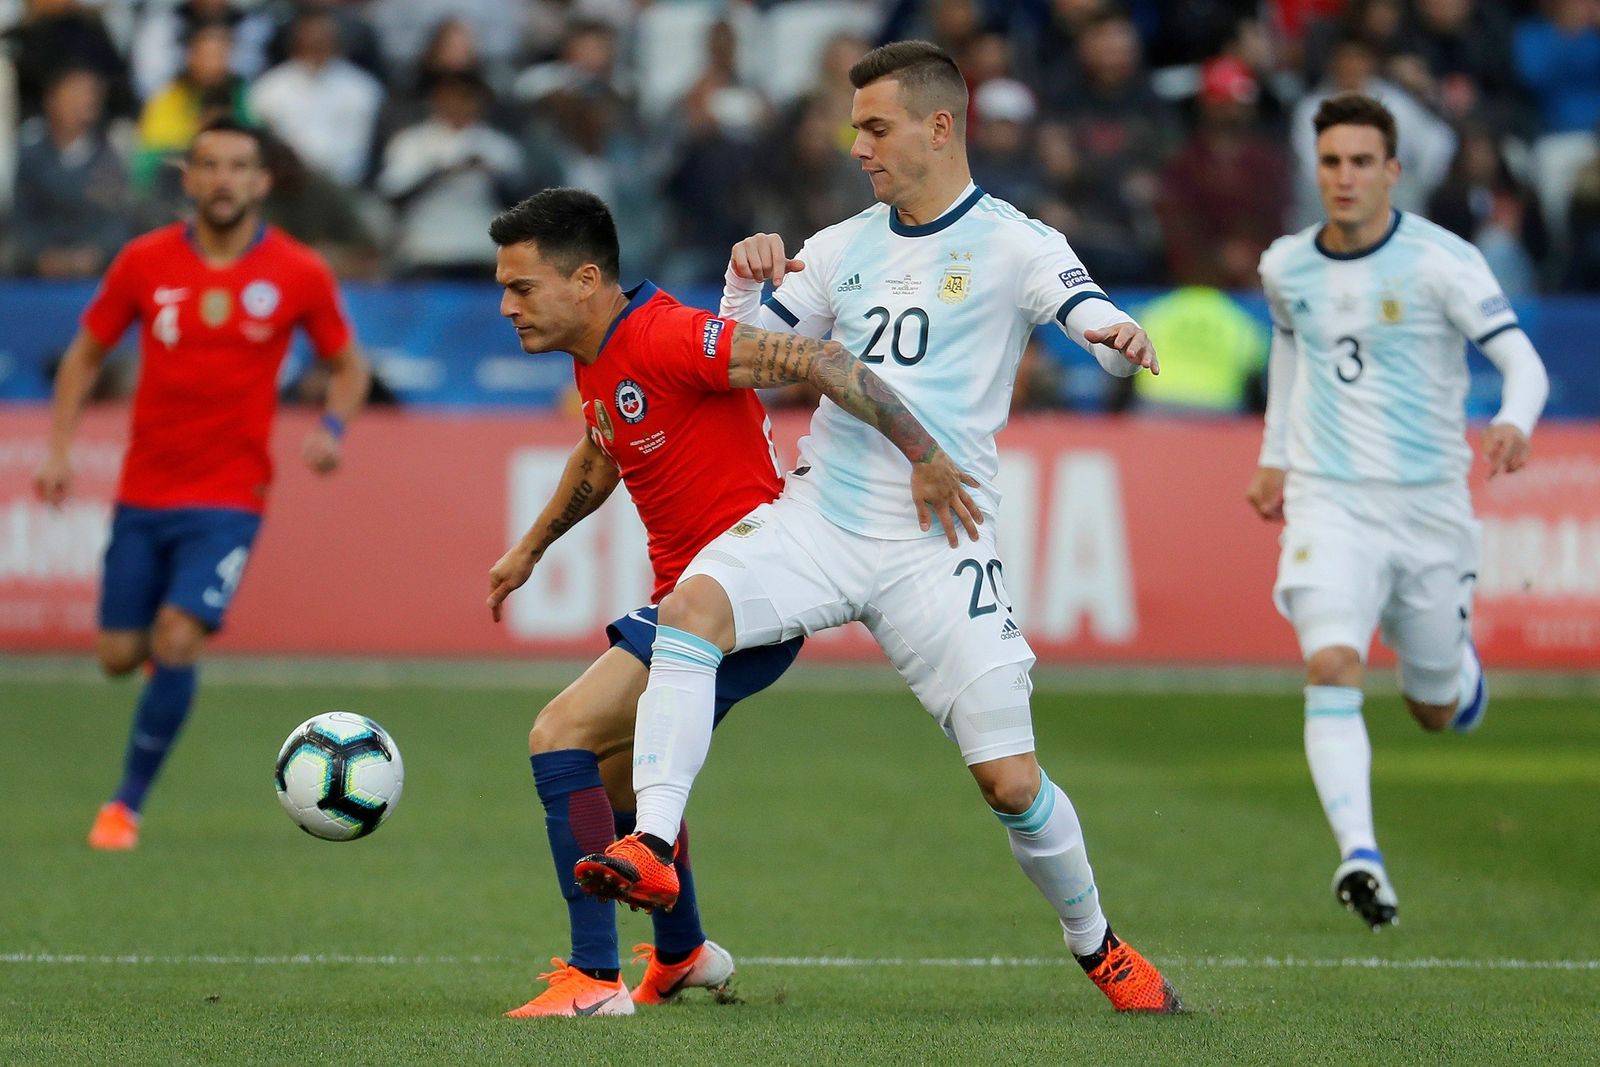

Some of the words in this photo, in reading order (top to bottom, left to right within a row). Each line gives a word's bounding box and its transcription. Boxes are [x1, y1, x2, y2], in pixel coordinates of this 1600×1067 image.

[837, 283, 862, 293] adidas
[706, 324, 720, 356] grande
[859, 306, 929, 366] 20
[1336, 336, 1363, 383] 3
